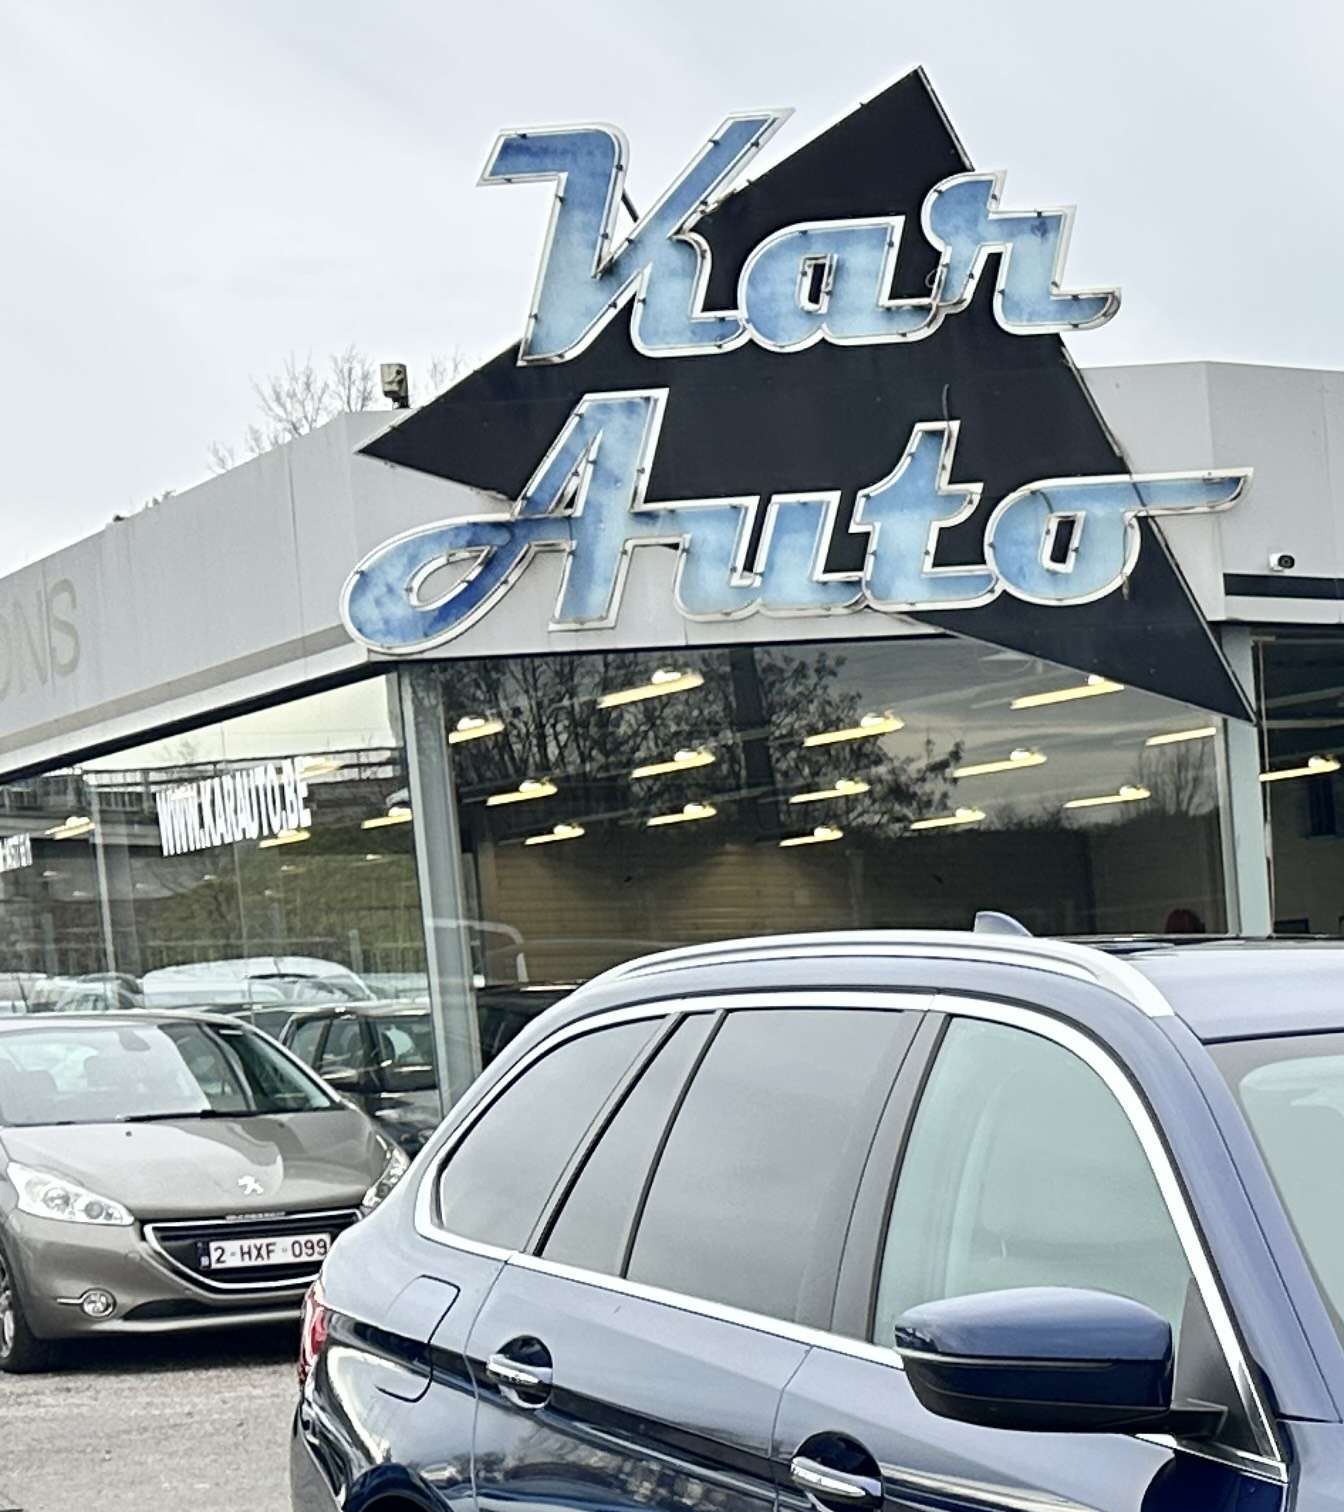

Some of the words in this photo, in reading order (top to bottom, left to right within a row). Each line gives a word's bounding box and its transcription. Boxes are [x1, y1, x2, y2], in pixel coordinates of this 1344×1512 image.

[476, 106, 1122, 366] Kar
[341, 387, 1255, 654] Auto
[156, 757, 312, 857] WWW.KARAUTO.BE
